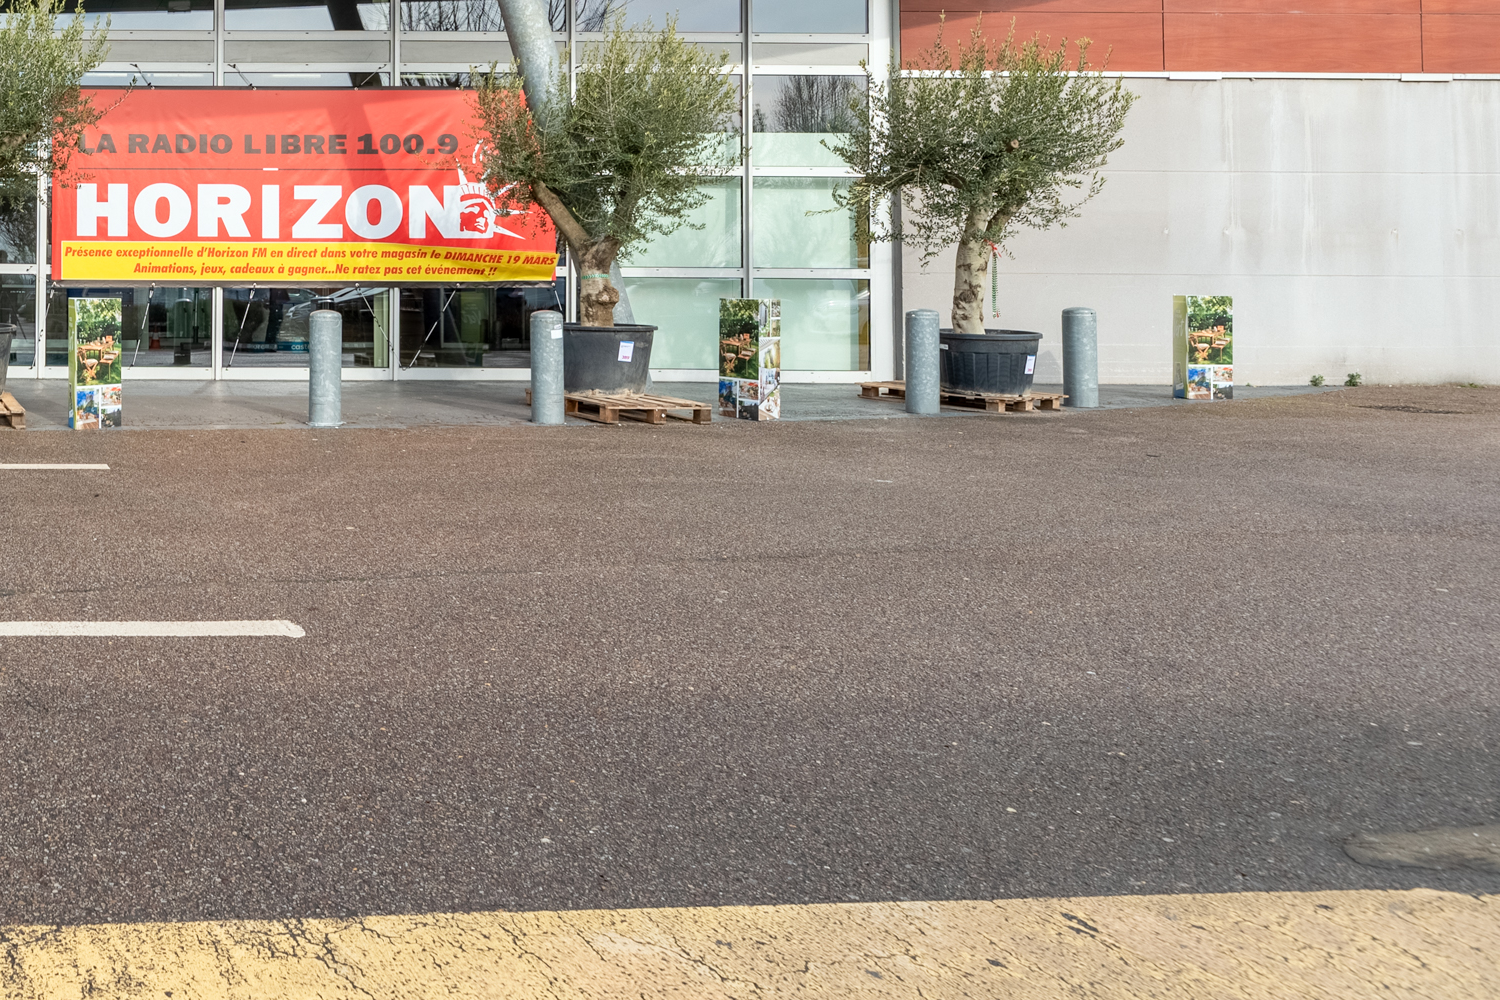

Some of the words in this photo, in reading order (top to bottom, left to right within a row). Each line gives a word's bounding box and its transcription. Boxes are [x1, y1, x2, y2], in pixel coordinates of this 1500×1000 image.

[78, 133, 117, 153] LA
[128, 133, 233, 155] RADIO
[244, 133, 348, 155] LIBRE
[357, 133, 459, 156] 100.9
[76, 182, 463, 240] HORIZON
[64, 245, 113, 257] Présence
[116, 246, 193, 259] exceptionnelle
[251, 247, 268, 258] FM
[270, 249, 284, 258] en
[285, 247, 318, 258] direct
[320, 248, 347, 258] dans
[350, 249, 378, 259] votre
[381, 248, 428, 261] magasin
[430, 249, 441, 259] le
[443, 251, 504, 264] DIMANCHE
[506, 254, 520, 264] 19
[522, 255, 556, 265] MARS
[133, 262, 198, 274] Animations,
[200, 263, 226, 276] jeux,
[229, 263, 275, 274] cadeaux
[277, 263, 284, 274] à
[352, 265, 381, 275] ratez
[384, 266, 403, 277] pas
[406, 265, 422, 275] cet
[424, 264, 486, 276] événement
